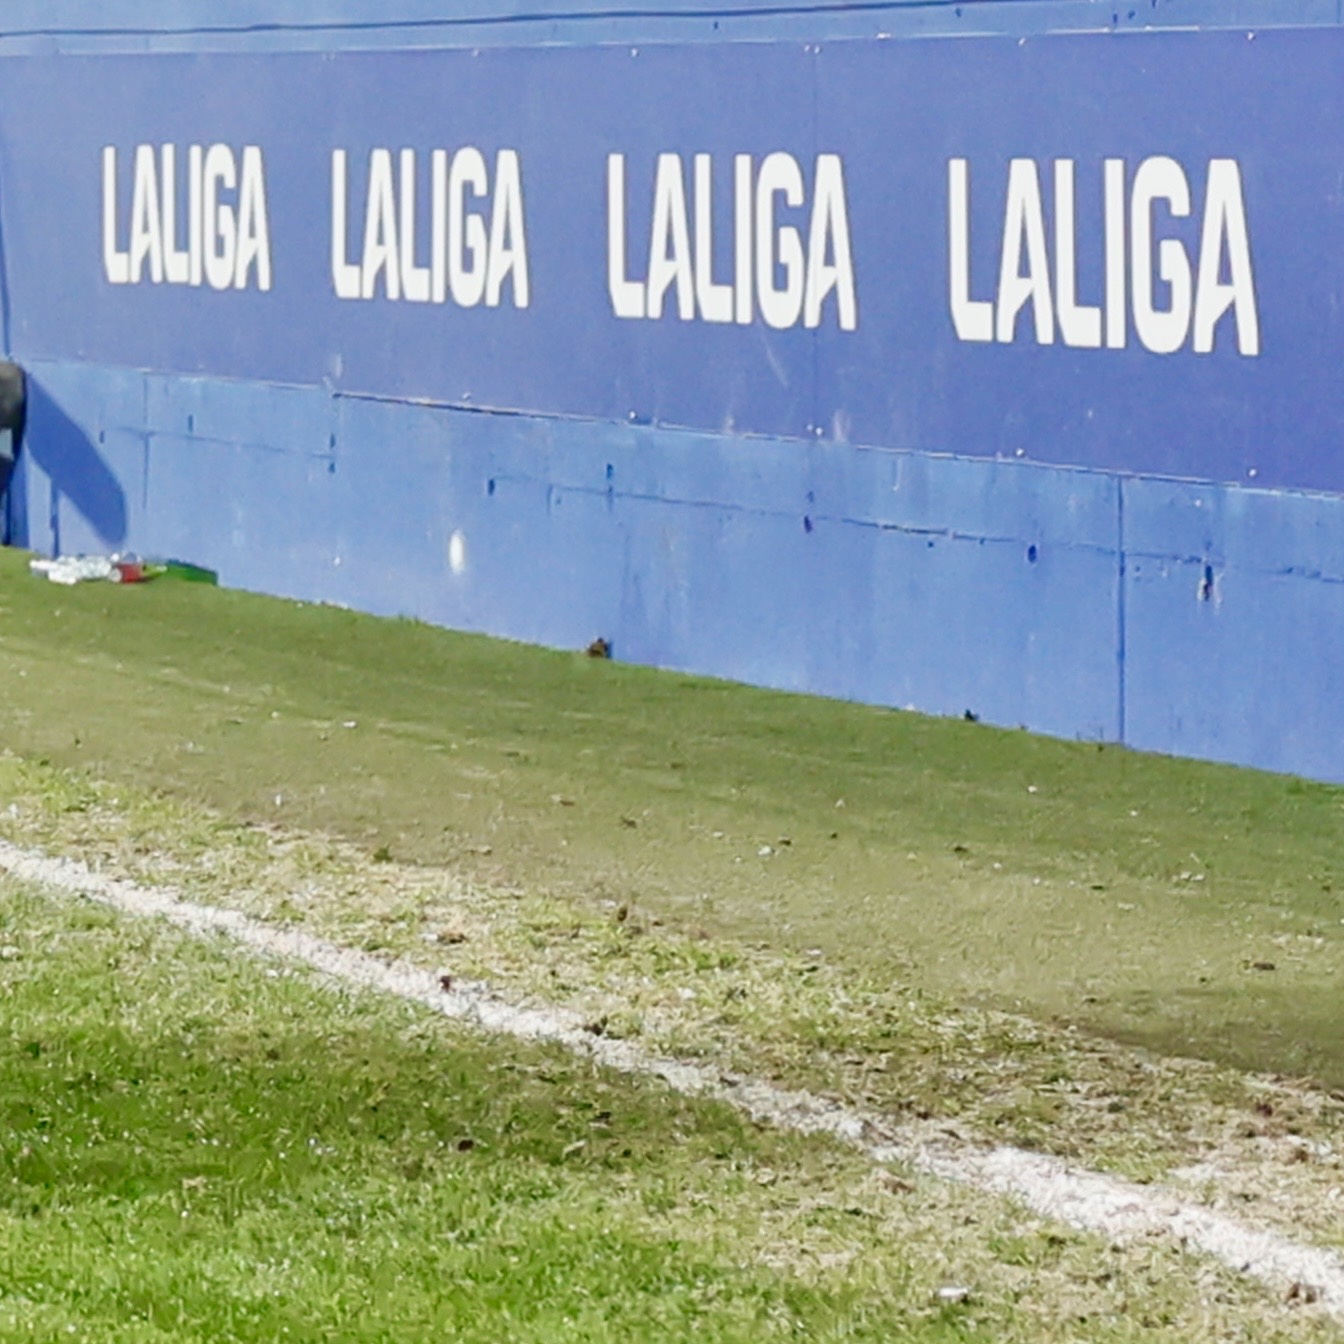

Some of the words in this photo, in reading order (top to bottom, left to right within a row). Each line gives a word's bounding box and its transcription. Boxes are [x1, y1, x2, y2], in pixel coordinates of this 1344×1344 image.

[103, 142, 271, 292] LALIGA
[332, 147, 529, 308] LALIGA
[609, 152, 857, 330] LALIGA
[948, 156, 1259, 355] LALIGA
